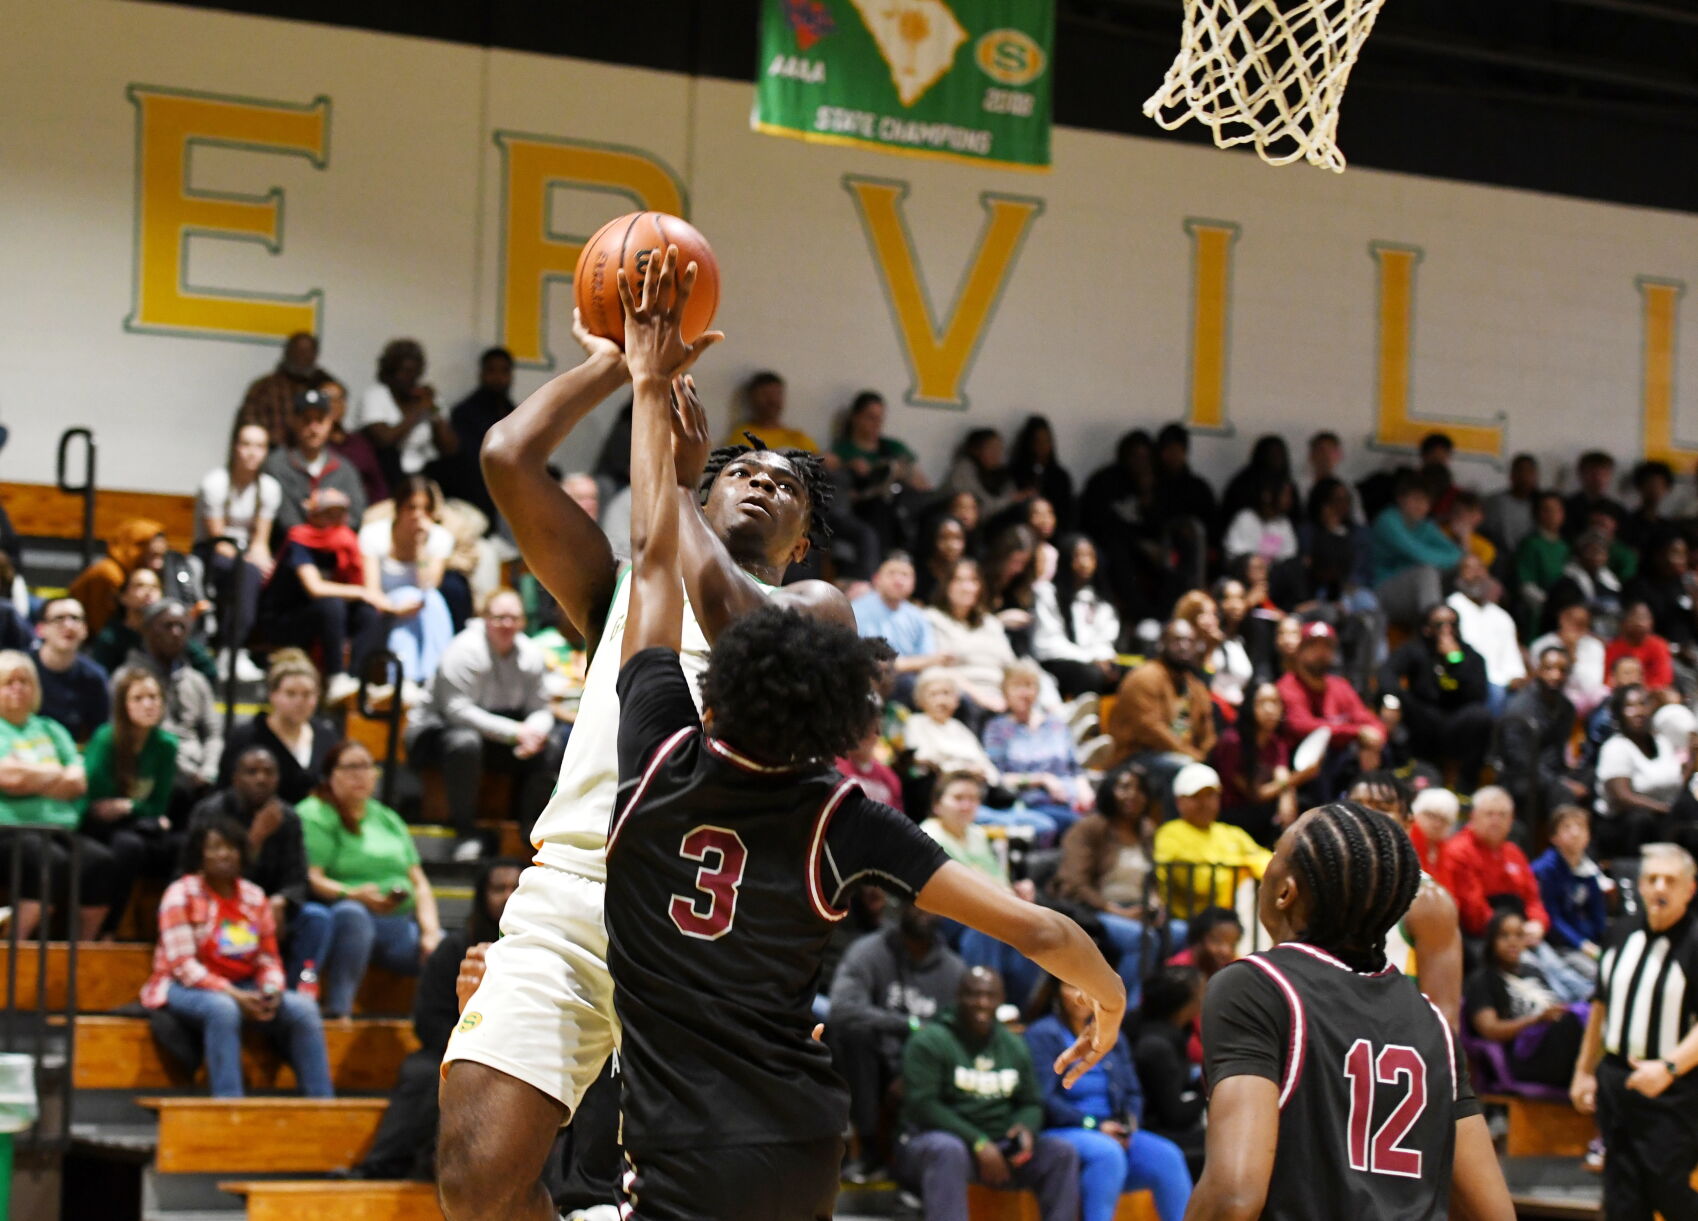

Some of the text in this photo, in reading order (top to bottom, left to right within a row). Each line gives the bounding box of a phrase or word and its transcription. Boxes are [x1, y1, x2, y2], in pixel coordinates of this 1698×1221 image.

[814, 105, 992, 154] STATE CHAMPIONS
[668, 824, 748, 941] 3
[1343, 1038, 1428, 1179] 12
